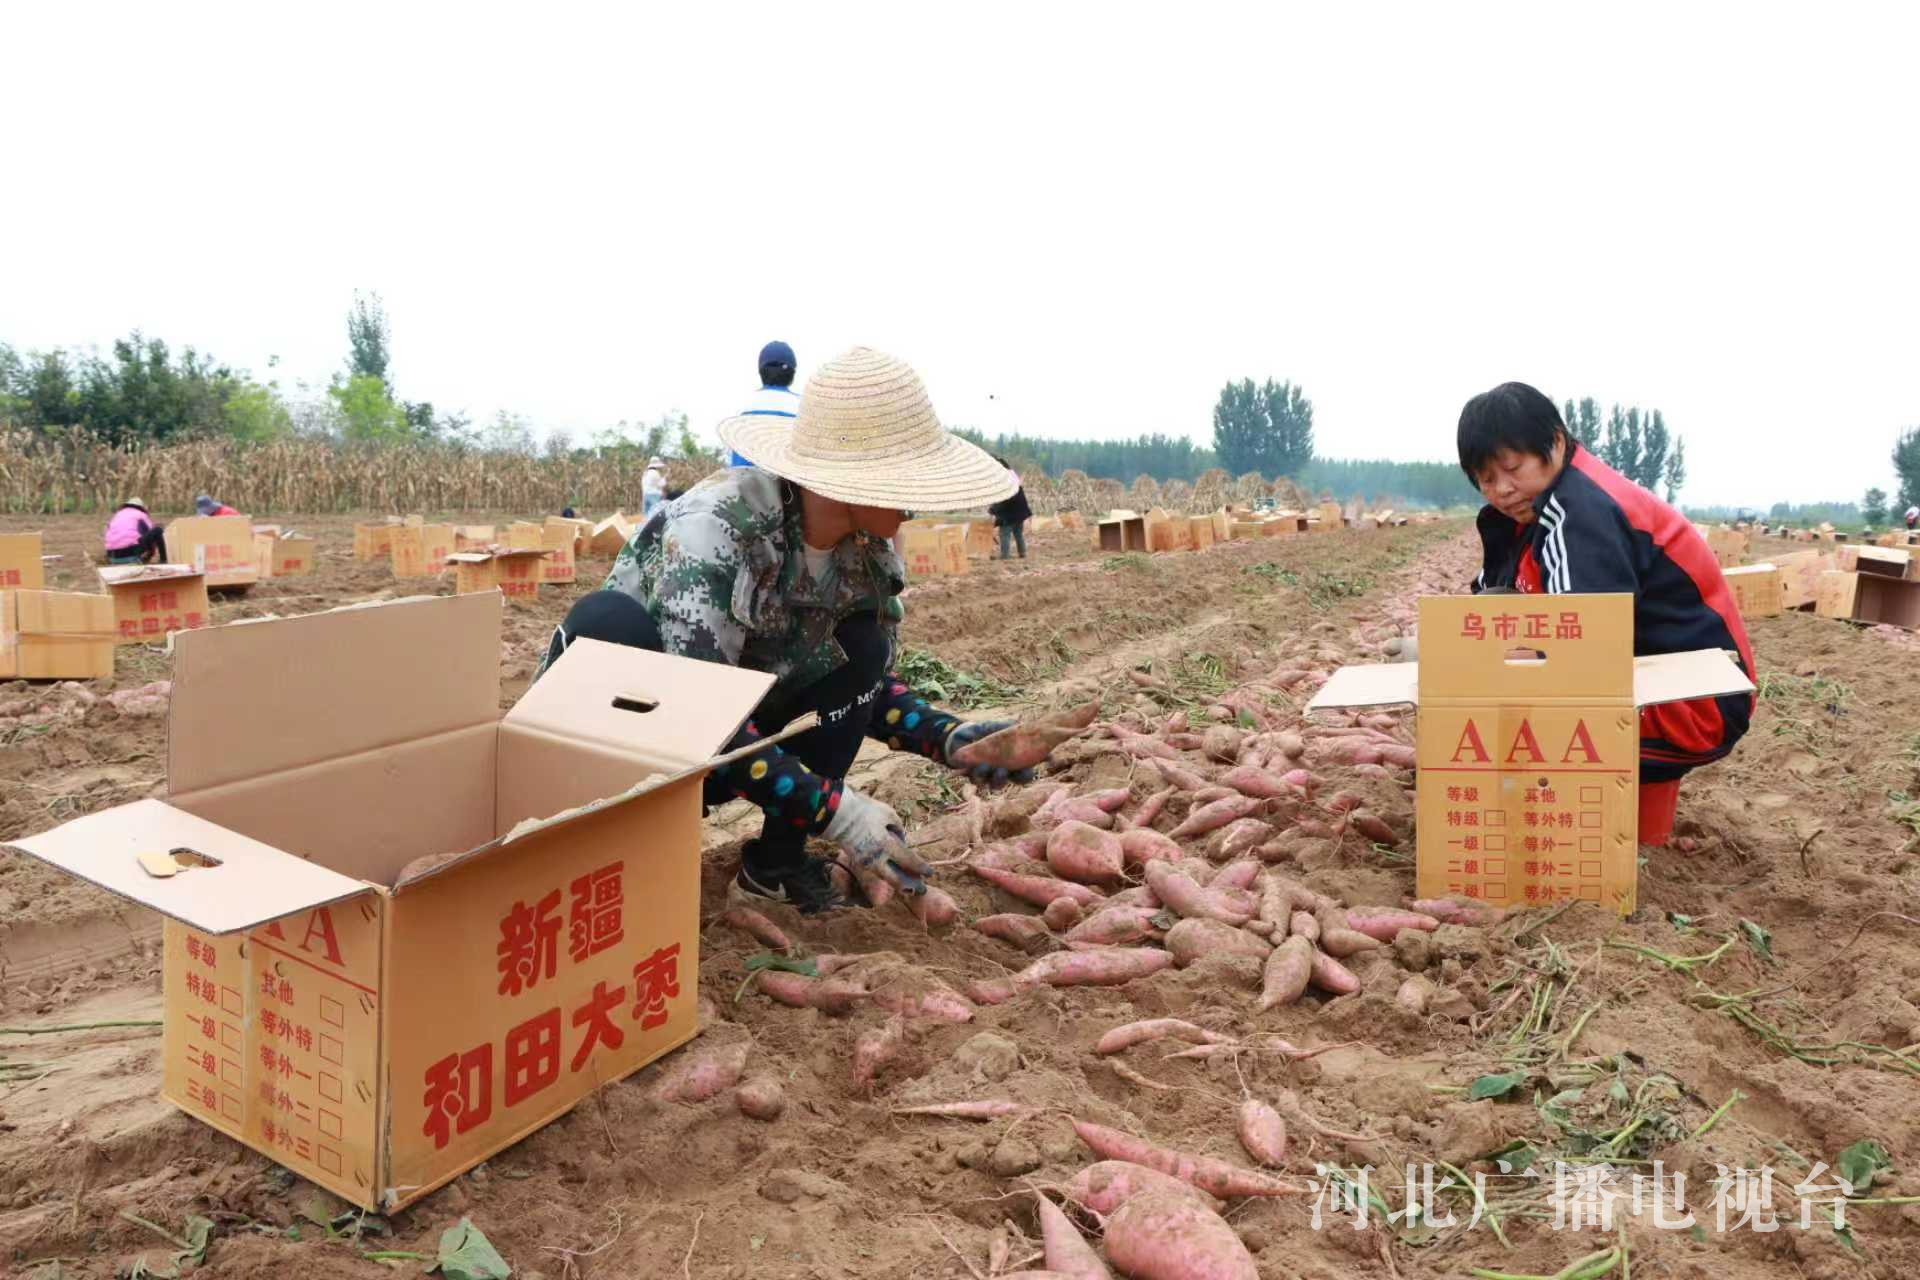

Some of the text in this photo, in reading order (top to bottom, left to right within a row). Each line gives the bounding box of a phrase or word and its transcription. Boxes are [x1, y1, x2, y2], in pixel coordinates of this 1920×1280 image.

[1461, 612, 1583, 641] 乌市正品
[1447, 786, 1479, 802] 等级
[1524, 787, 1557, 803] 其他
[1447, 811, 1479, 827] 特级
[1523, 811, 1574, 828] 等外特
[1447, 834, 1479, 850] 一级
[1523, 835, 1575, 852] 等外一
[1447, 859, 1479, 875] 二级
[1524, 860, 1574, 877] 等外二
[496, 860, 625, 997] 新疆
[186, 934, 217, 968] 等级
[186, 970, 217, 1006] 特级
[261, 969, 295, 1007] 其他
[186, 1013, 217, 1041] 一级
[260, 1008, 313, 1053] 等外特
[186, 1044, 217, 1077] 二级
[260, 1044, 313, 1080] 等外一
[423, 942, 681, 1151] 和田大枣
[186, 1077, 217, 1111] 三级
[260, 1080, 312, 1123] 等外二
[261, 1118, 312, 1161] 等外三
